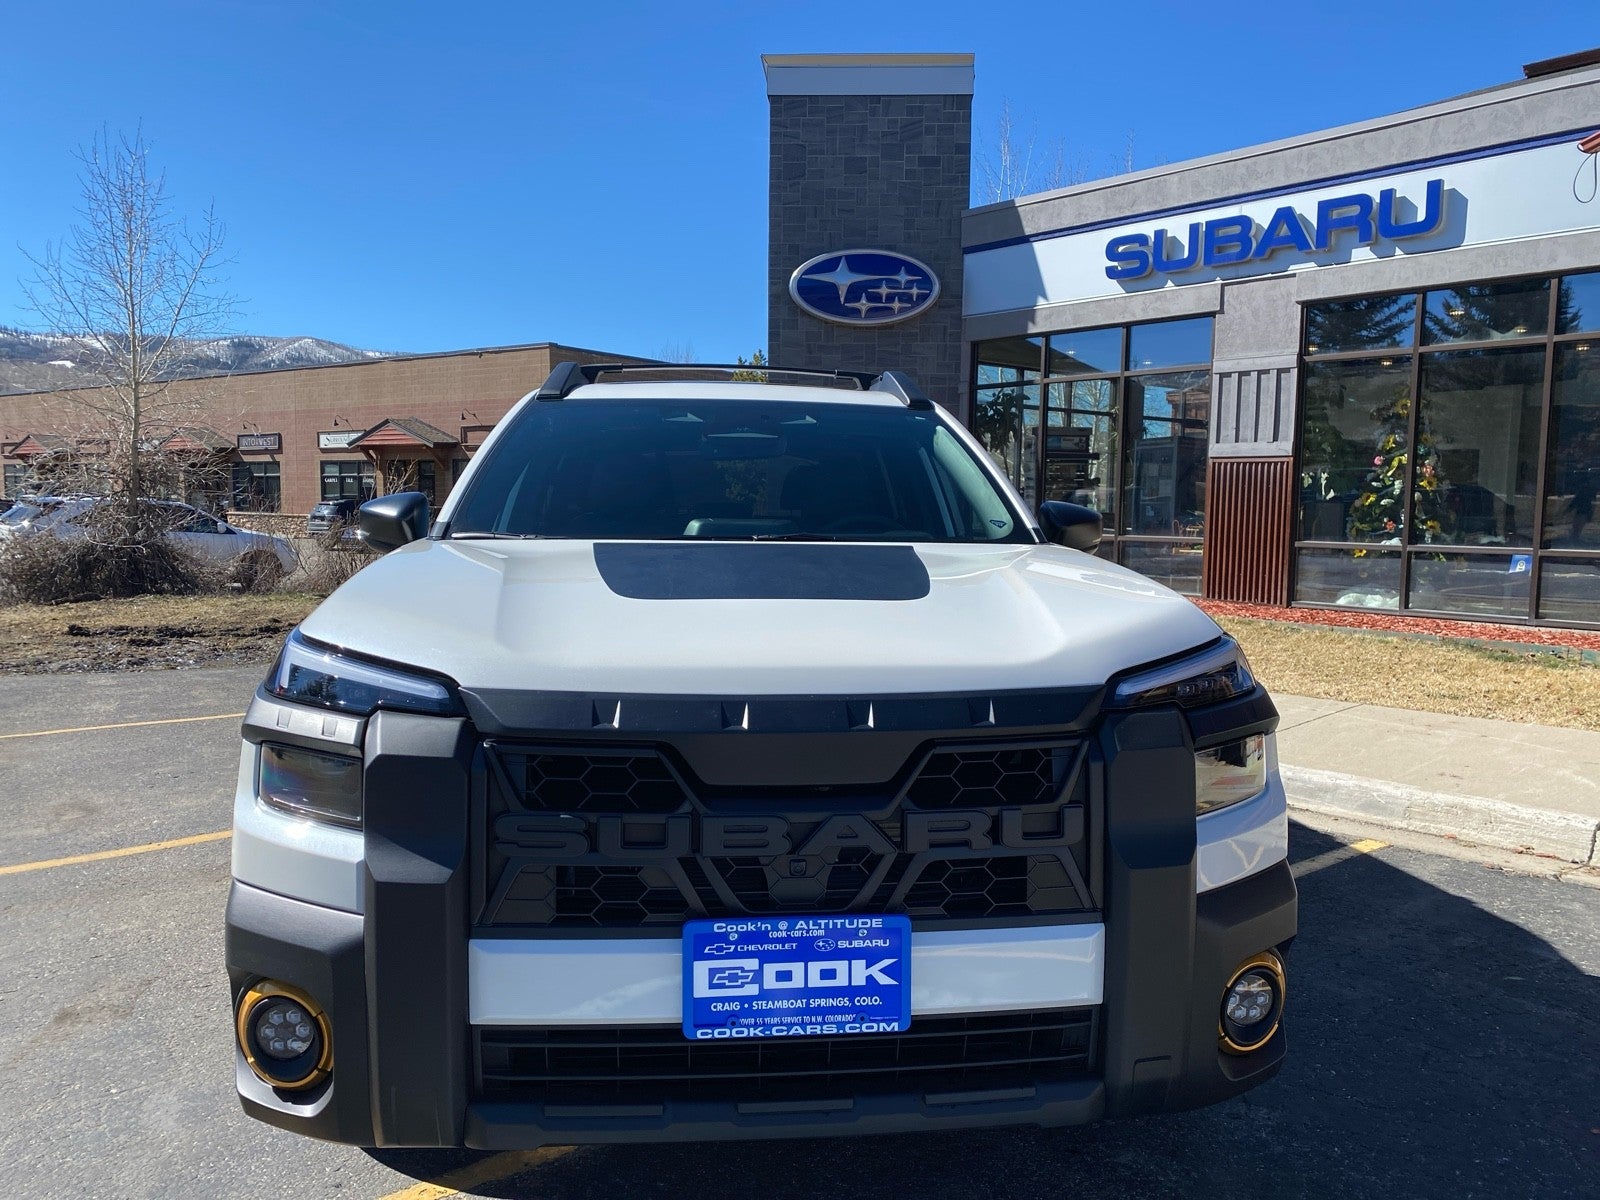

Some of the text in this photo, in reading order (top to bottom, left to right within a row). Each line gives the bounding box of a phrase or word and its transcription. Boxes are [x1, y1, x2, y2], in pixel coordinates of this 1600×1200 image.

[1104, 179, 1445, 280] SUBARU
[494, 804, 1084, 858] SUBARU
[713, 921, 771, 933] Cook'n
[794, 918, 883, 930] ALTITUDE
[769, 929, 825, 938] cook-cars.com
[737, 942, 798, 952] CHEVROLET
[837, 939, 890, 949] SUBARU
[693, 958, 899, 998] COOK
[710, 996, 883, 1012] CRAIG STEAMBOAT SPRINGS, COLO.
[764, 1016, 781, 1025] YEARS
[781, 1015, 802, 1024] SERVICE
[803, 1015, 811, 1024] TO
[696, 1021, 900, 1040] COOK-CARS.COM
